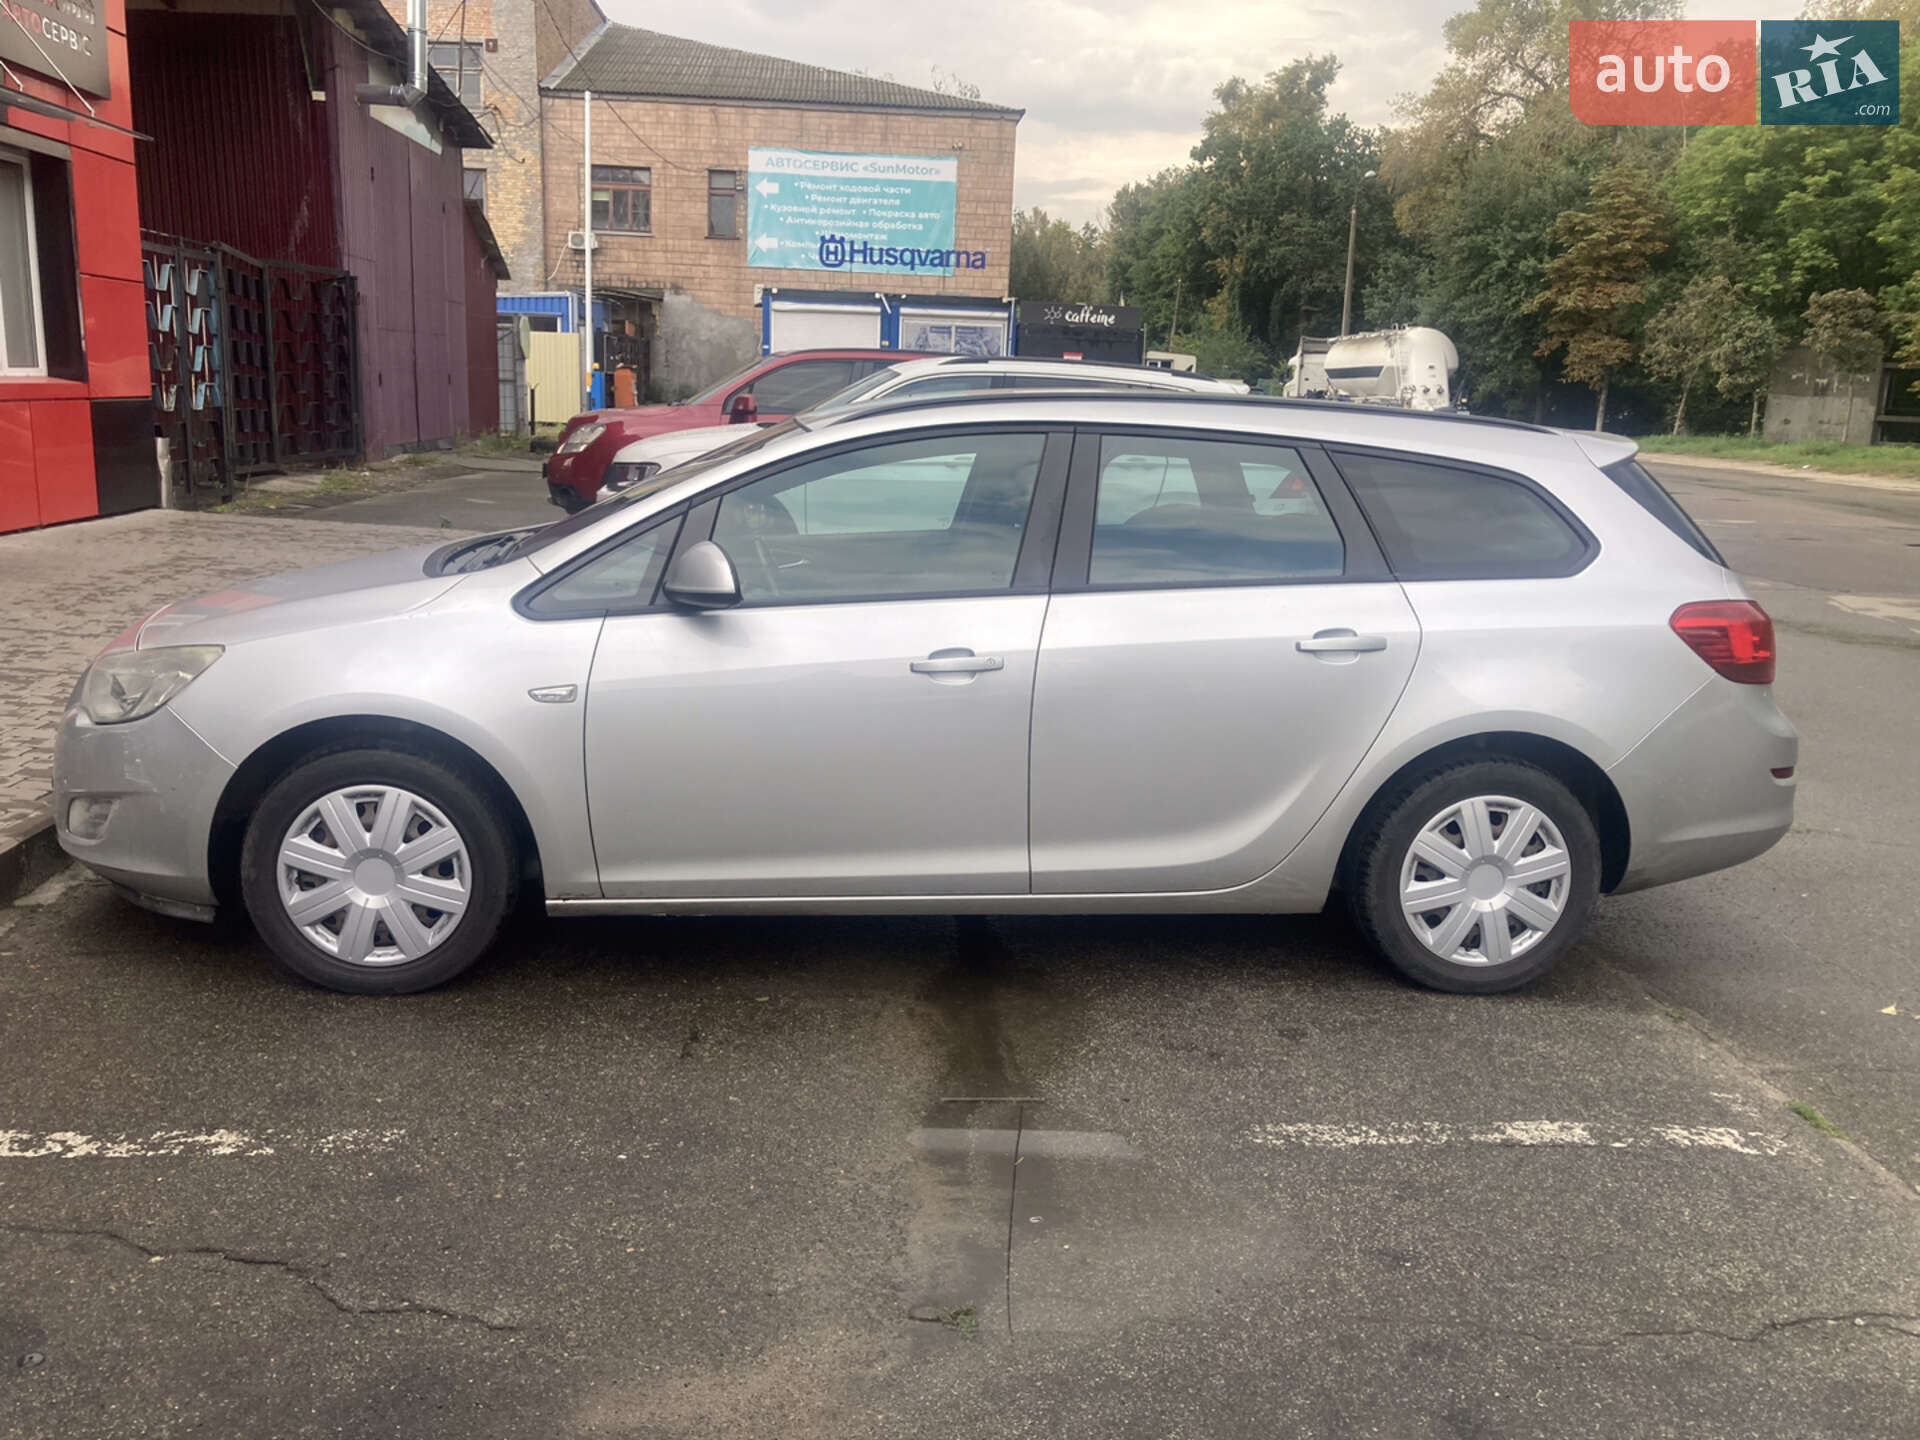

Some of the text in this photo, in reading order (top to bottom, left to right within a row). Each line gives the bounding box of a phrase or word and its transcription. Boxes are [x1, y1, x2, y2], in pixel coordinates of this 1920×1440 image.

[767, 157, 859, 172] АВТОСЕРВИС
[800, 181, 837, 192] Ремонт
[882, 185, 912, 195] части
[810, 193, 848, 204] Ремонт
[819, 207, 856, 216] ремонт
[849, 240, 986, 270] Husqvarna
[1065, 306, 1115, 327] caffeine
